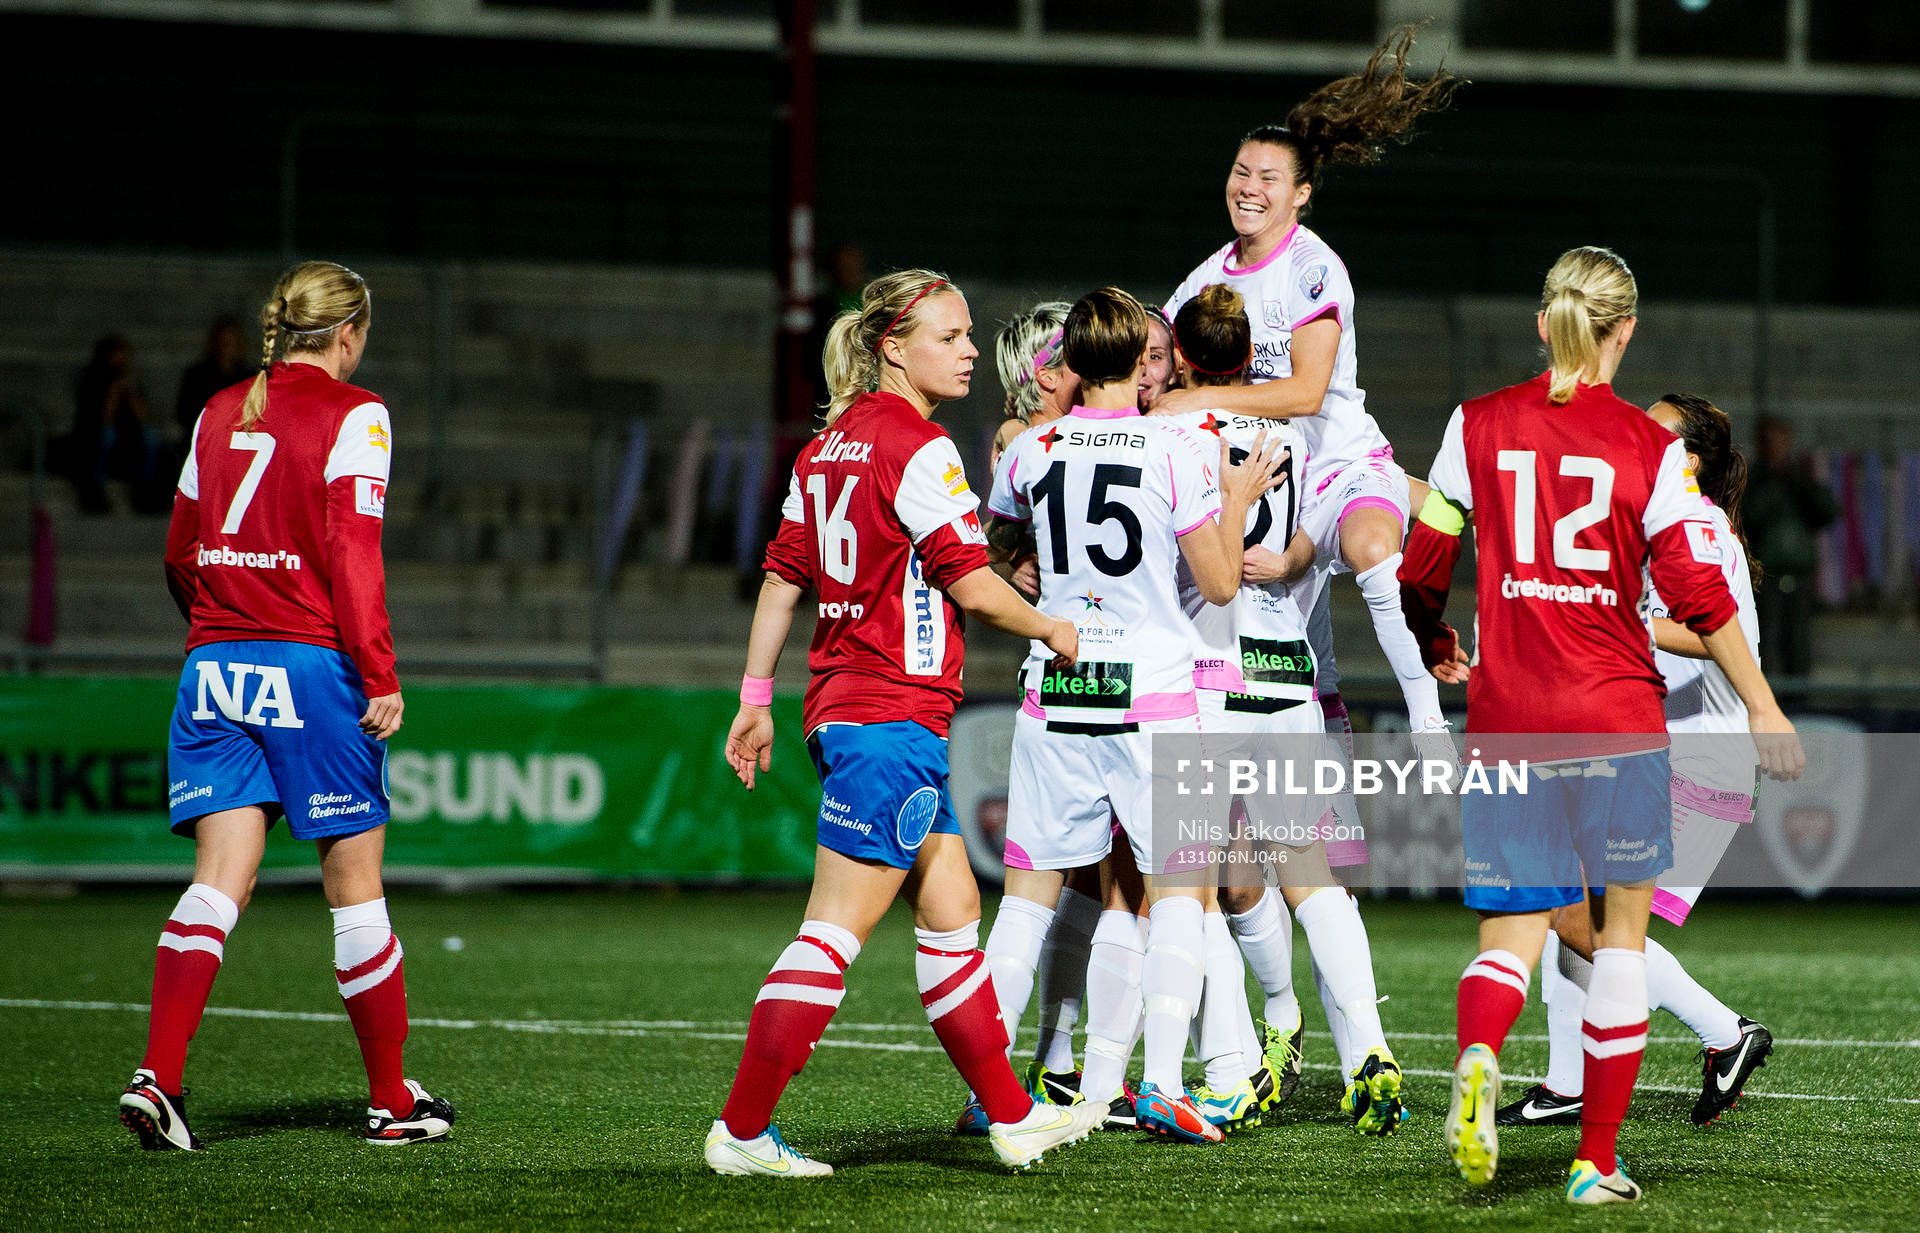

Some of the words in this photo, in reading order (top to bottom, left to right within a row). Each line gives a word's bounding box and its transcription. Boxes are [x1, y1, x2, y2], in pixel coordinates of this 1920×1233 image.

[220, 431, 277, 535] 7
[1030, 460, 1144, 578] 15
[1497, 449, 1616, 572] 12
[806, 473, 861, 586] 16
[192, 660, 304, 729] NA
[1042, 671, 1099, 695] akea
[1194, 660, 1225, 669] SELECT
[1243, 649, 1296, 672] akea
